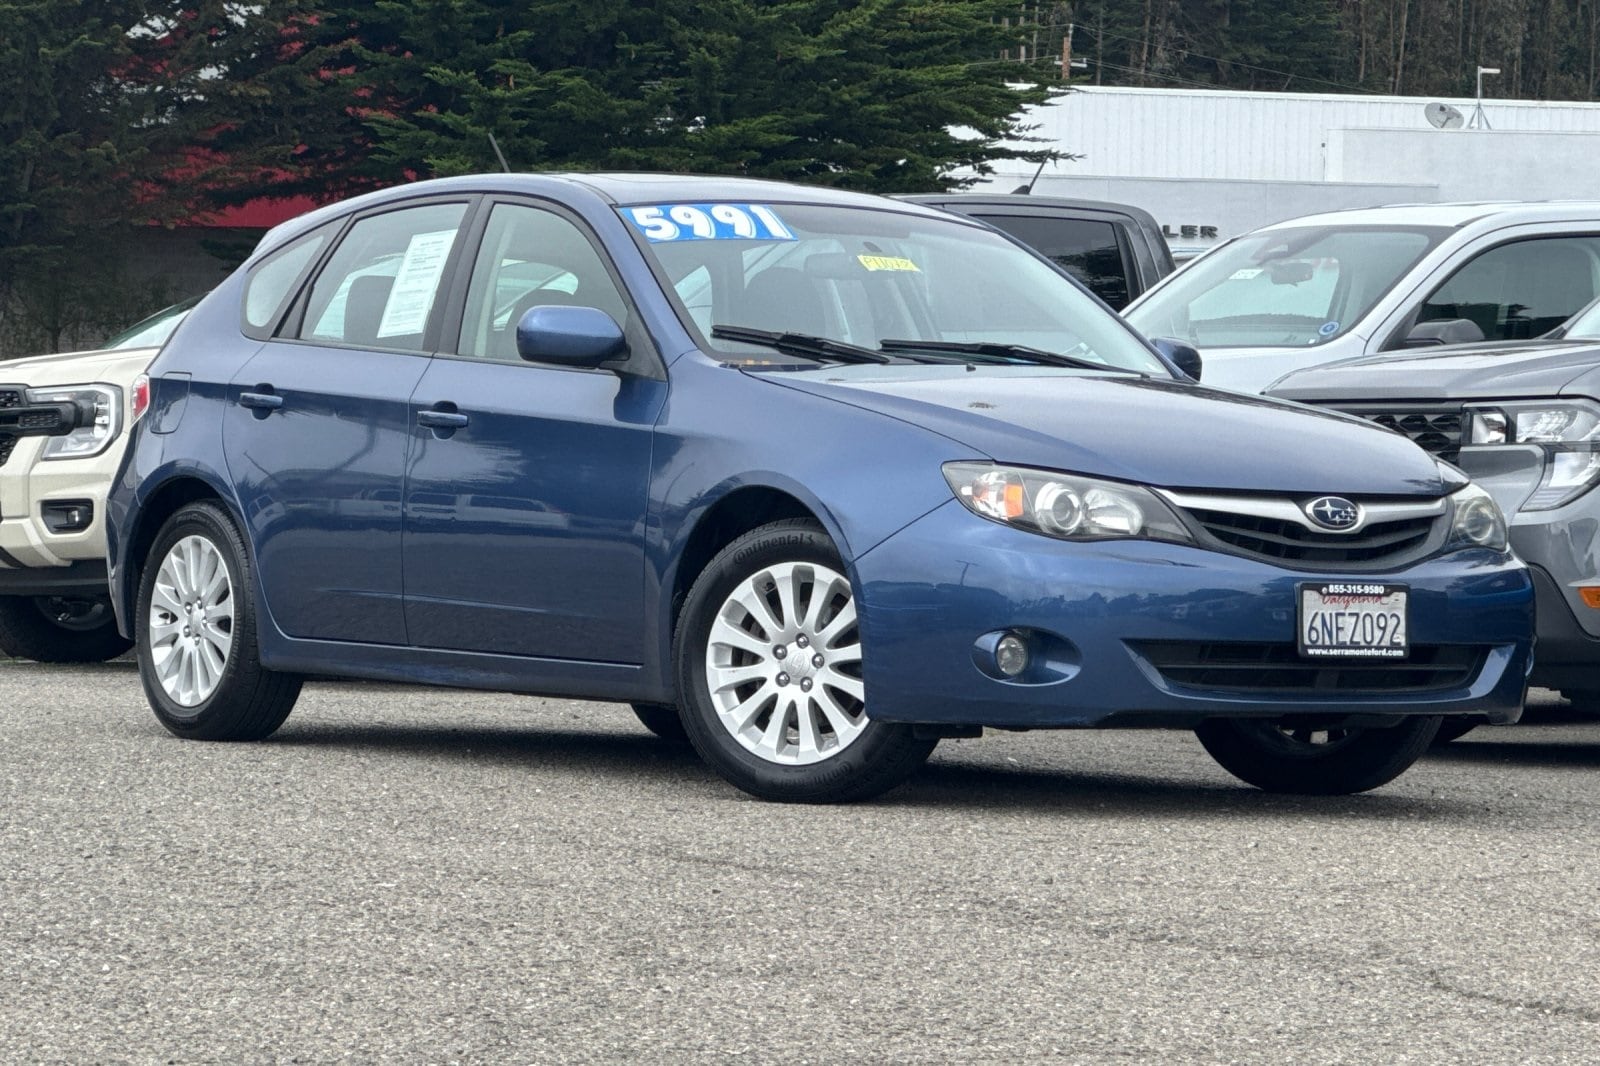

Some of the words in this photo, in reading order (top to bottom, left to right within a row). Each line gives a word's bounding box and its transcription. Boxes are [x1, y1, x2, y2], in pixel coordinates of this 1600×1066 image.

[631, 205, 793, 241] 5991
[733, 533, 805, 564] Continental
[1328, 584, 1385, 594] 855-315-9580
[1307, 611, 1402, 646] 6NEZ092
[1307, 648, 1404, 656] www.serramonteford.com
